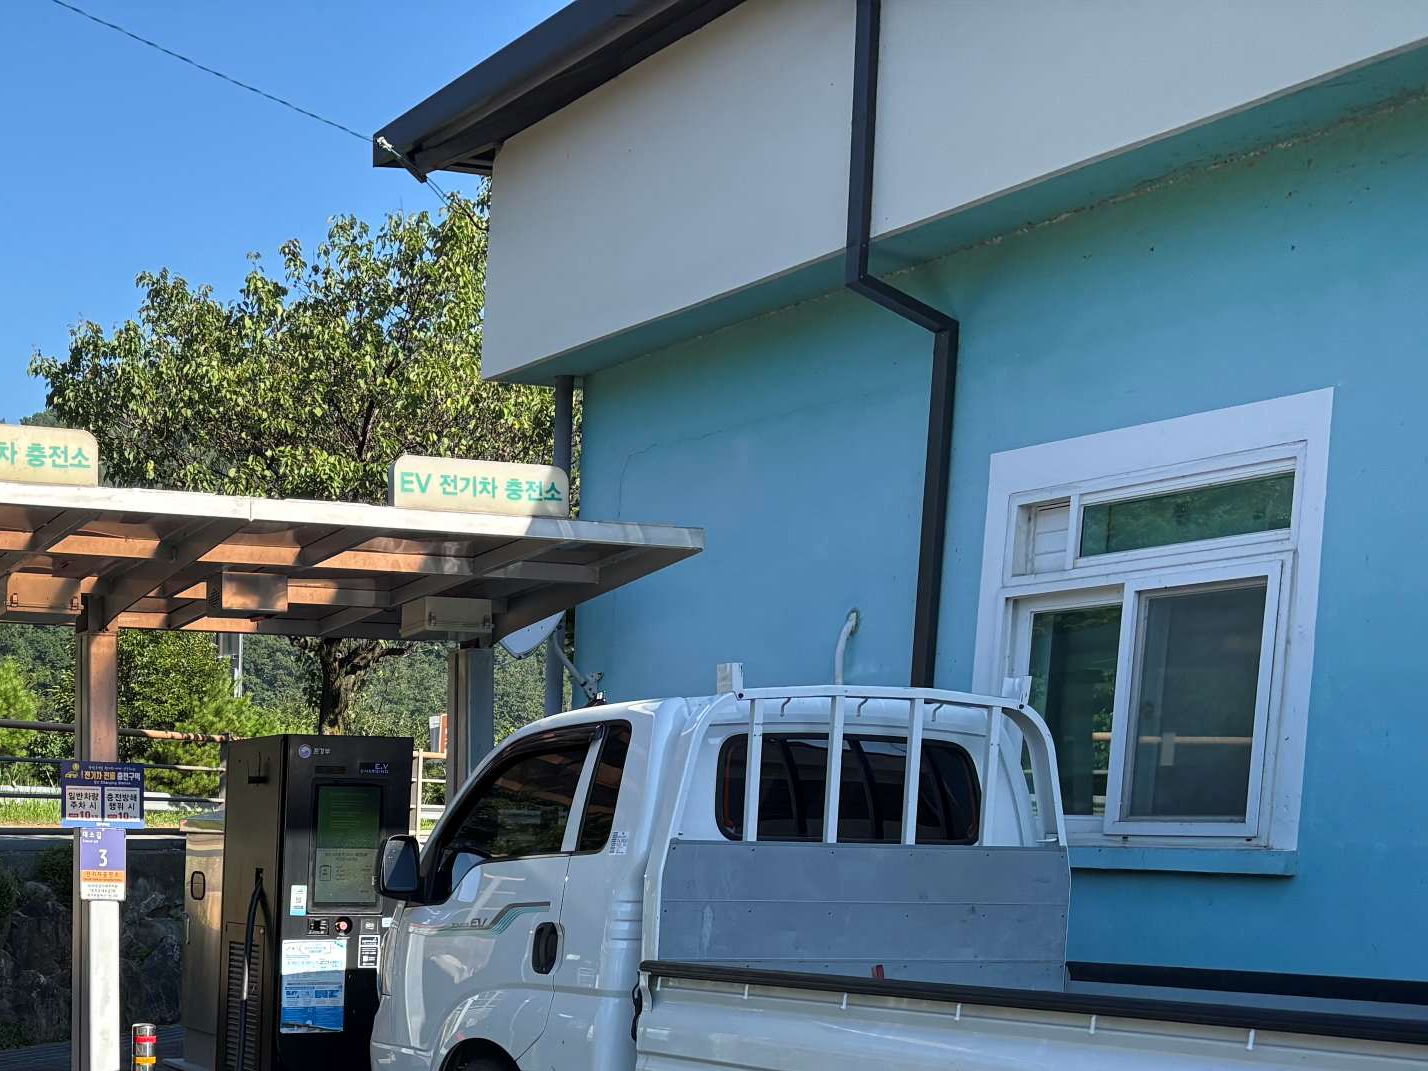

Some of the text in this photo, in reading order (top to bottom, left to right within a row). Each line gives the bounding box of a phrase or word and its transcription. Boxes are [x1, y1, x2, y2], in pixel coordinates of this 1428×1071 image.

[25, 442, 92, 468] 충전소
[400, 472, 563, 501] EV 전기차 충전소
[68, 792, 99, 801] 일반차량
[107, 793, 138, 802] 충전방해
[70, 801, 97, 810] 주차 시
[109, 802, 135, 811] 행위 시
[80, 811, 91, 819] 10
[98, 849, 108, 867] 3
[471, 918, 488, 928] EV
